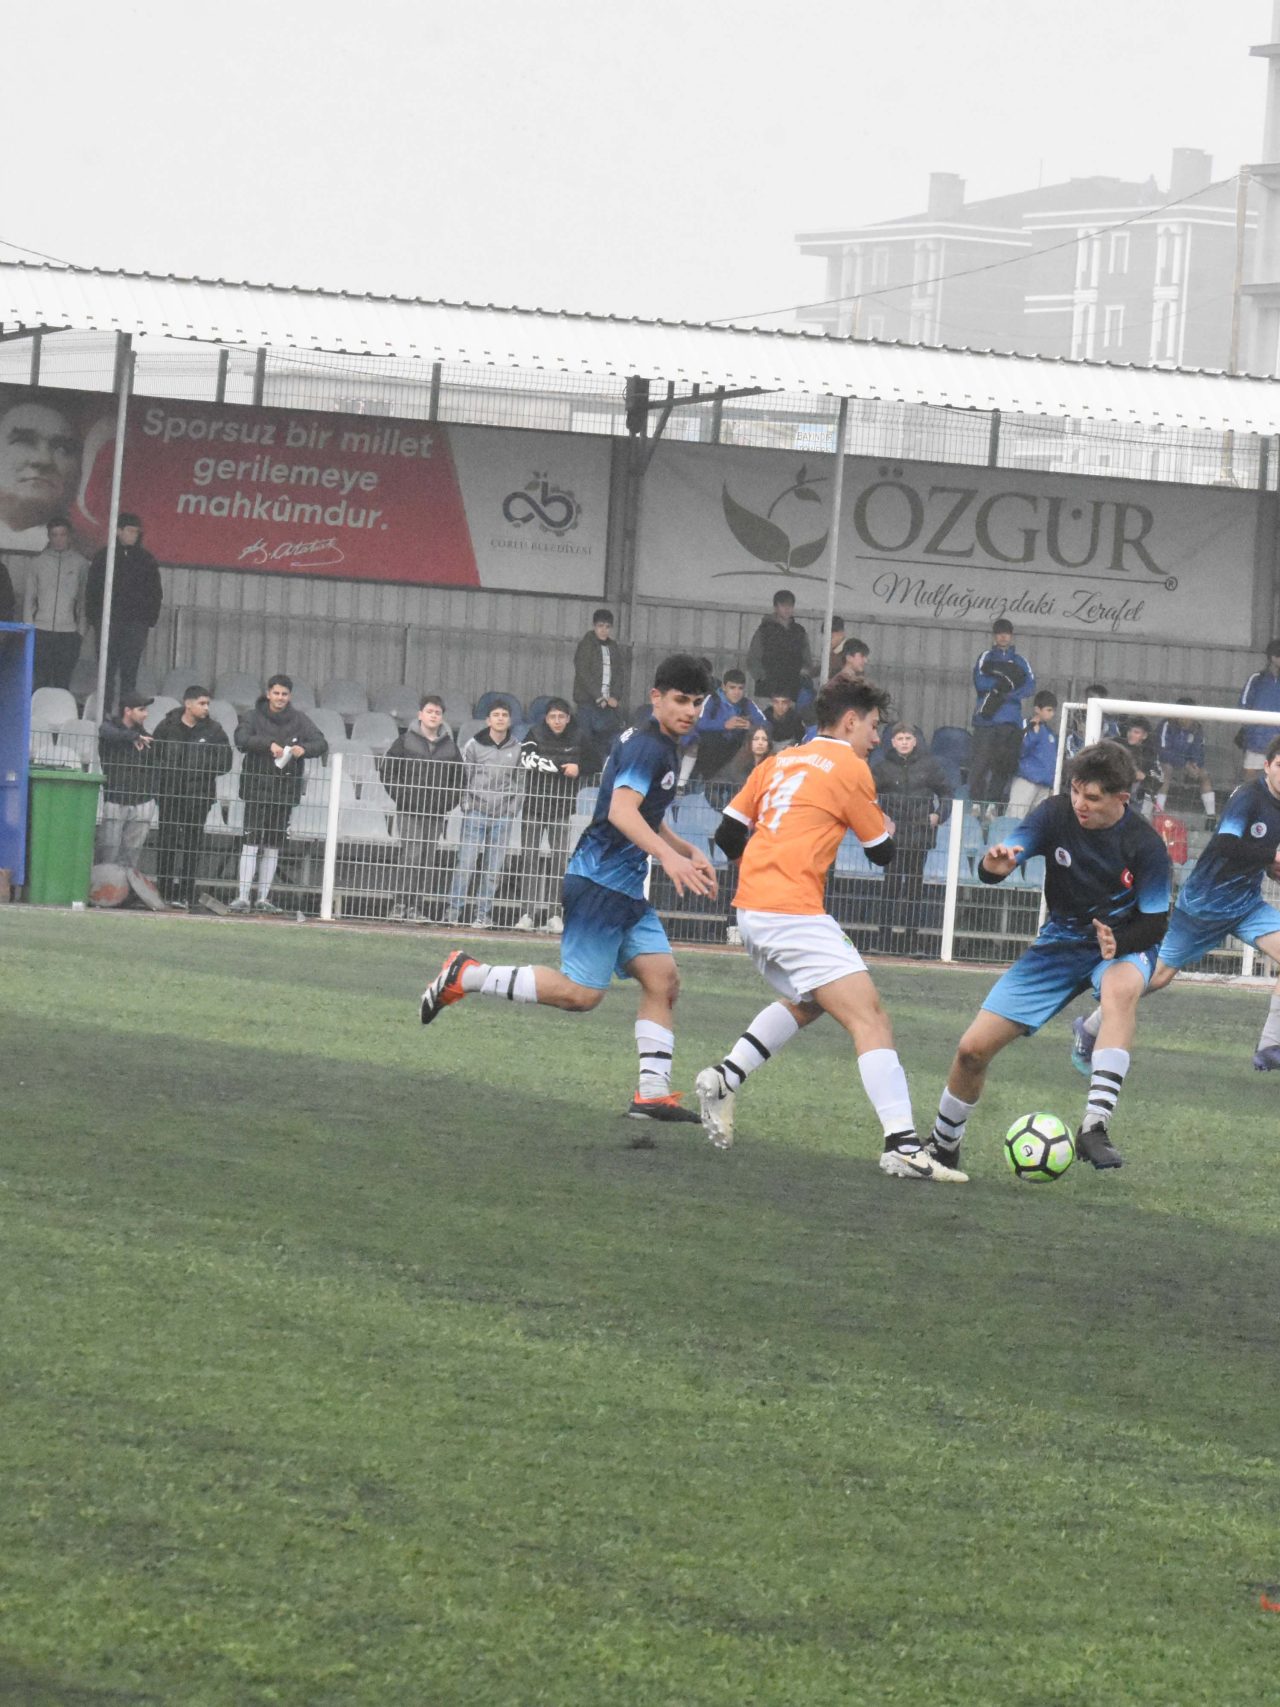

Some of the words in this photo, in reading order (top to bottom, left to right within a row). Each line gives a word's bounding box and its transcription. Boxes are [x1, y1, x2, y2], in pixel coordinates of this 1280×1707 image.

[142, 408, 276, 446] Sporsuz
[285, 420, 333, 450] bir
[340, 426, 434, 459] millet
[193, 454, 379, 495] gerilemeye
[176, 491, 388, 531] mahkûmdur.
[852, 465, 1170, 575] ÖZGÜR
[1062, 589, 1146, 631] Zerafet
